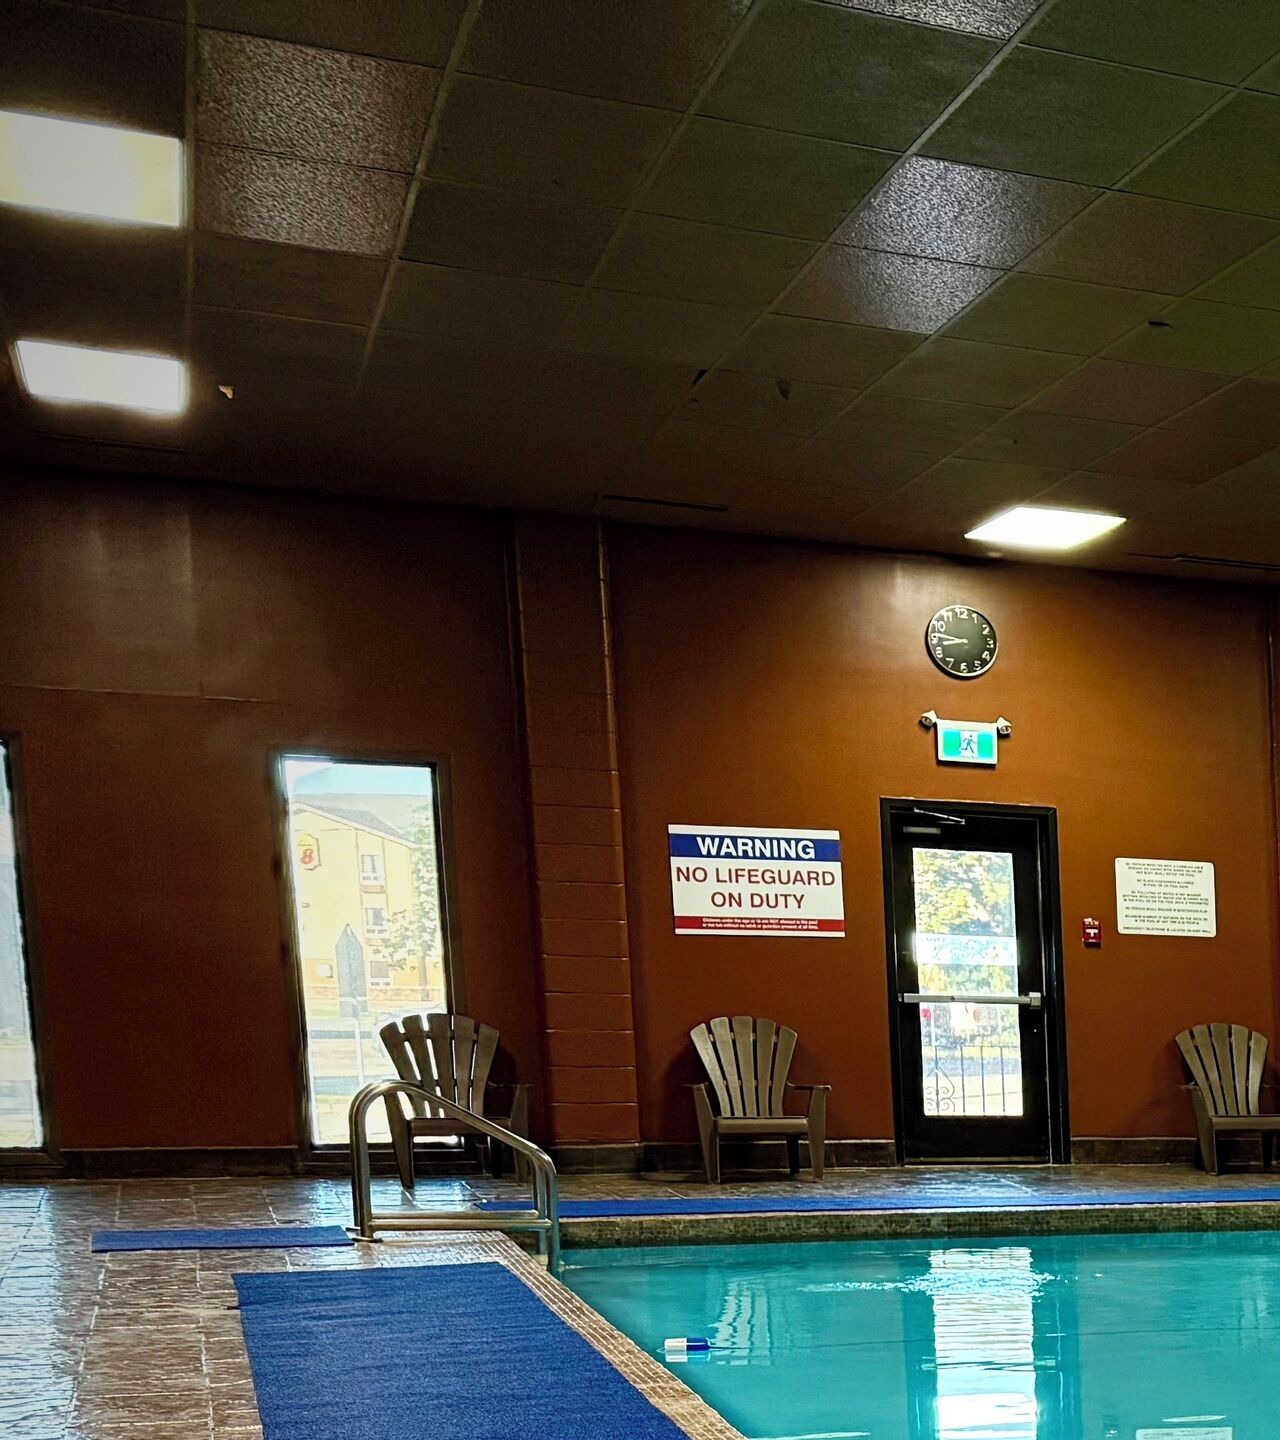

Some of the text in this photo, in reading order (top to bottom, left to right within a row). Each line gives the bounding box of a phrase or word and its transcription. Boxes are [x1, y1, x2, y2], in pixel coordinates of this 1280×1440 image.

[941, 609, 953, 622] 11
[955, 608, 968, 619] 12
[972, 614, 978, 624] 1
[932, 620, 945, 632] 10
[982, 624, 990, 635] 2
[931, 633, 939, 644] 9
[987, 638, 994, 648] 3
[936, 647, 943, 658] 8
[982, 650, 990, 661] 4
[945, 658, 954, 668] 7
[960, 663, 968, 673] 6
[974, 660, 981, 670] 5
[696, 836, 815, 859] WARNING
[300, 848, 314, 865] 8
[676, 866, 836, 886] NO LIFEGUARD
[711, 891, 805, 909] ON DUTY
